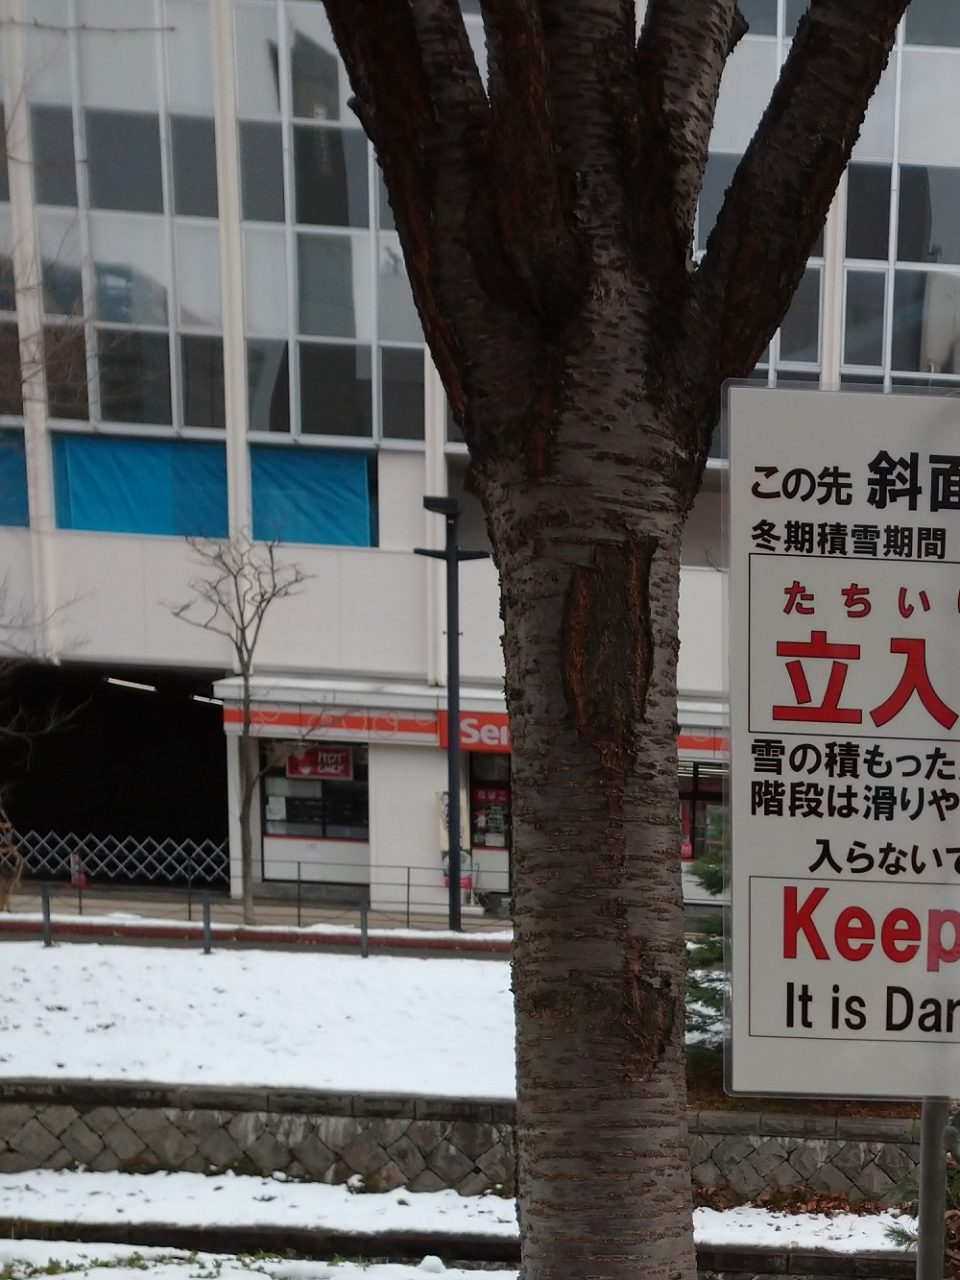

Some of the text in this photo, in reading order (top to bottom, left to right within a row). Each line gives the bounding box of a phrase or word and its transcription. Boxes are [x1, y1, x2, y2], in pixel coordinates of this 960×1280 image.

[751, 519, 947, 559] 冬期積雪期間
[786, 982, 813, 1028] It
[831, 984, 867, 1030] is
